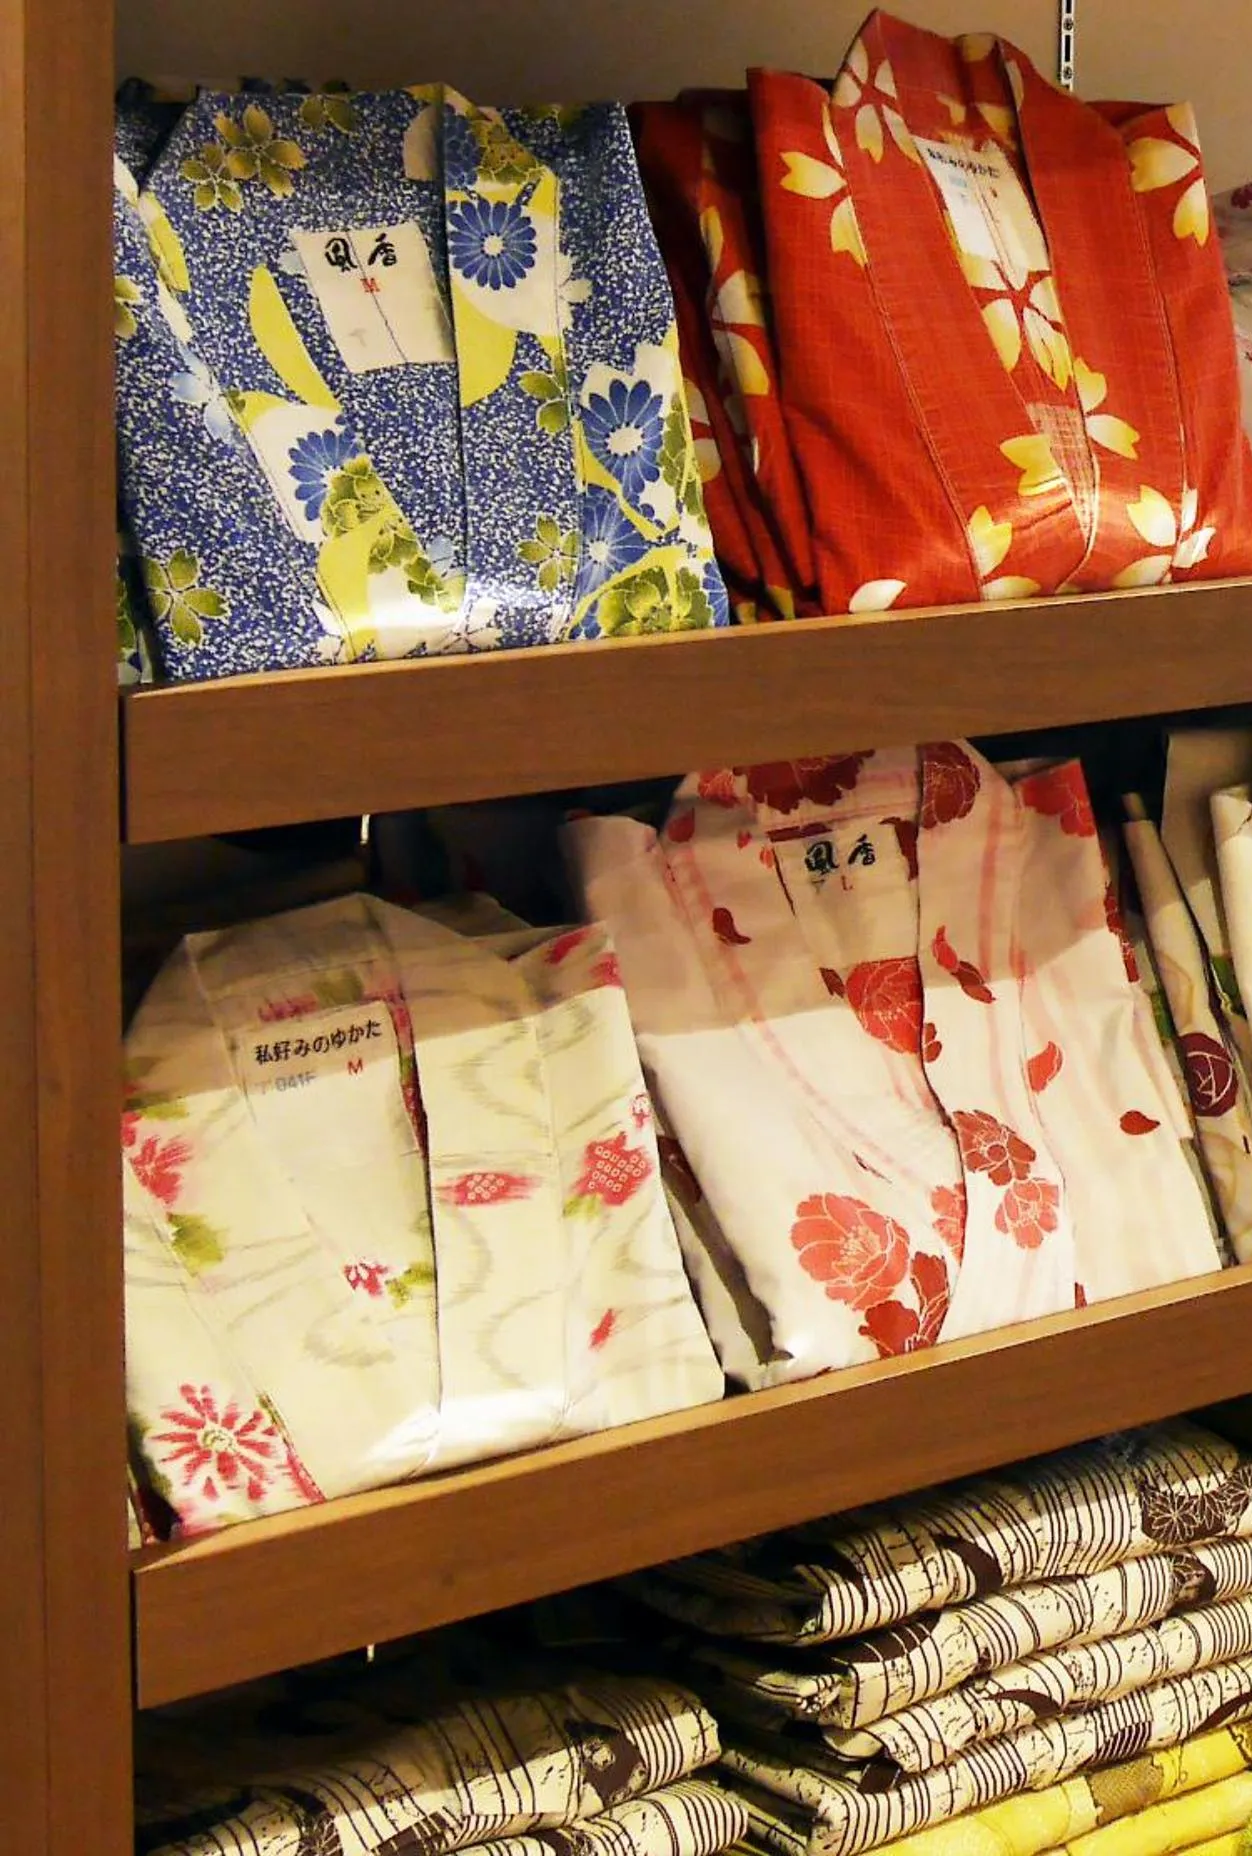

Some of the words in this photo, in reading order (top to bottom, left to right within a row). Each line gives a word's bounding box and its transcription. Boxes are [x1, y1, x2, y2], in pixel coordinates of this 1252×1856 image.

[360, 277, 380, 293] M
[254, 1018, 384, 1066] 私好みのゆかた
[346, 1057, 364, 1076] M
